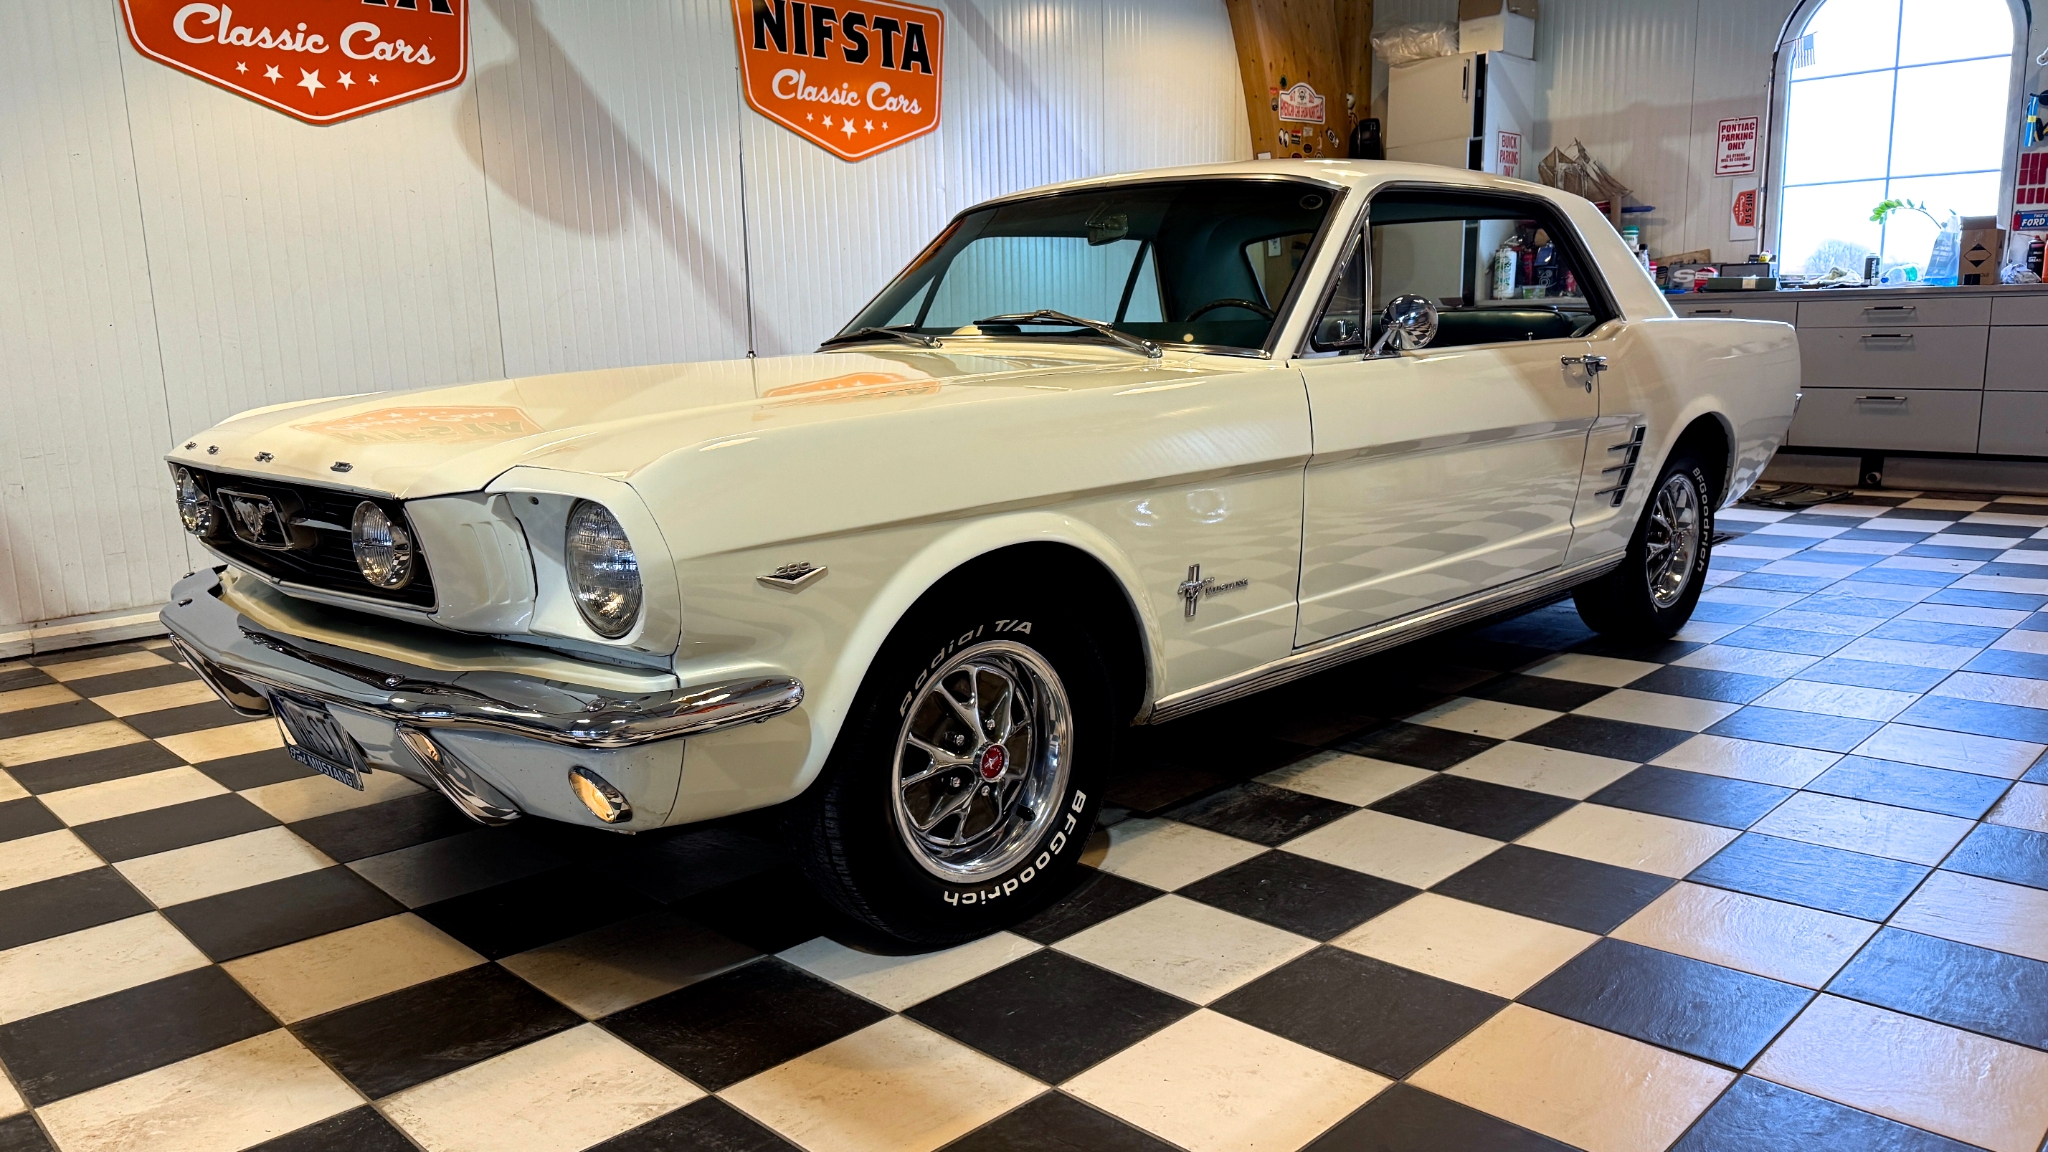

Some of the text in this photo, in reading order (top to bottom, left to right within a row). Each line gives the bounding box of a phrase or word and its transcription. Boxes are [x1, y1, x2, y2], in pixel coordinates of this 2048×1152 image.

[173, 3, 436, 65] Classic Cars
[752, 0, 934, 76] NIFSTA
[771, 68, 922, 115] Classic Cars
[1501, 134, 1517, 149] BUICK
[1721, 122, 1755, 133] PONTIAC
[1721, 132, 1754, 142] PARKING
[1499, 149, 1518, 165] PARKING
[1727, 141, 1746, 151] ONLY
[1745, 193, 1753, 224] NIFSTA
[2021, 217, 2046, 227] FORD
[1692, 467, 1710, 572] BFGoodrich
[900, 619, 1032, 717] Radial T/A
[308, 756, 354, 787] MUSTANG
[943, 789, 1087, 906] BFGoodrich
